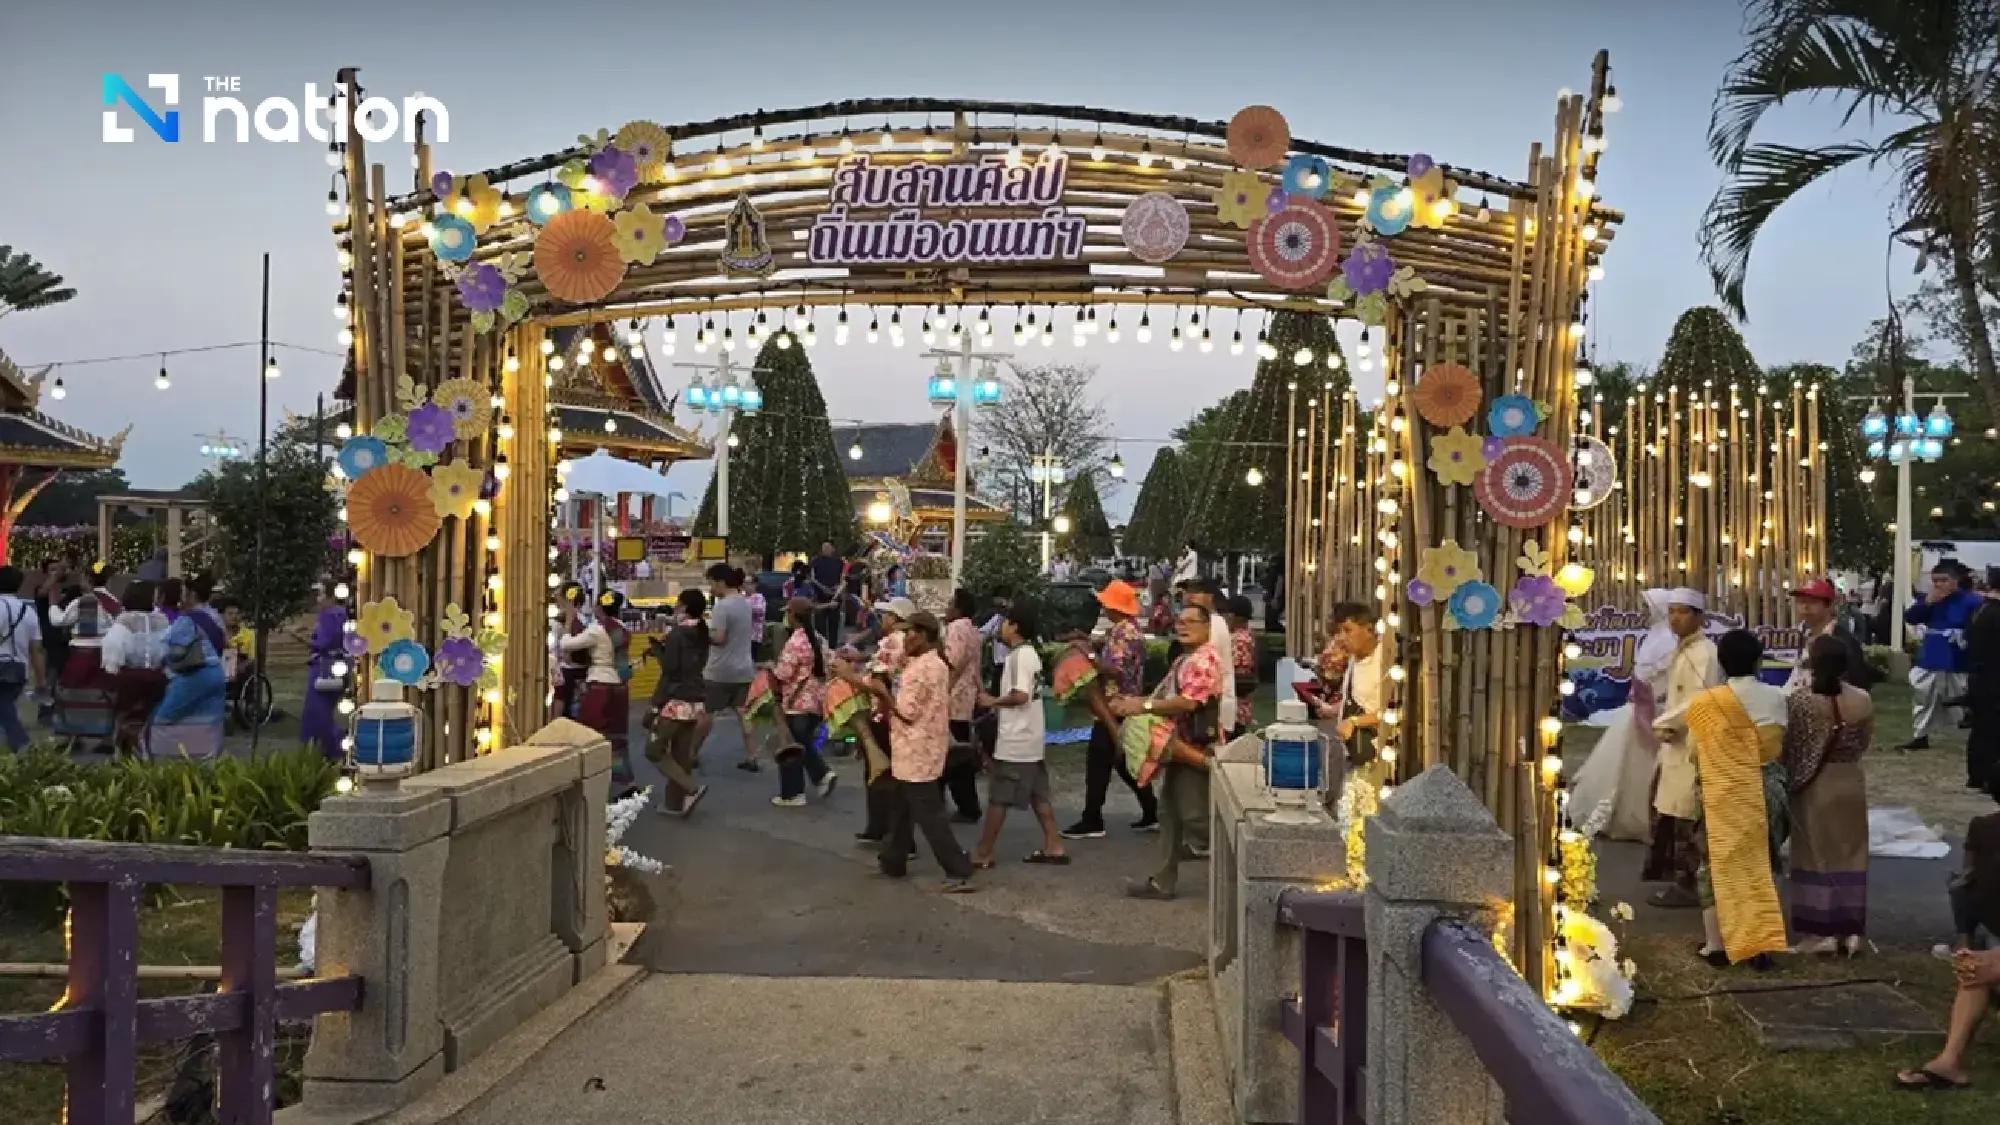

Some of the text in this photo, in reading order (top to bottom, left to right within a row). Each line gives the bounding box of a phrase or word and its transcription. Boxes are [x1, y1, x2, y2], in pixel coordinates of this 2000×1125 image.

[833, 155, 1066, 204] สืบสานศิลป์
[811, 204, 1083, 261] ถิ่นเมืองนนท์ฯ
